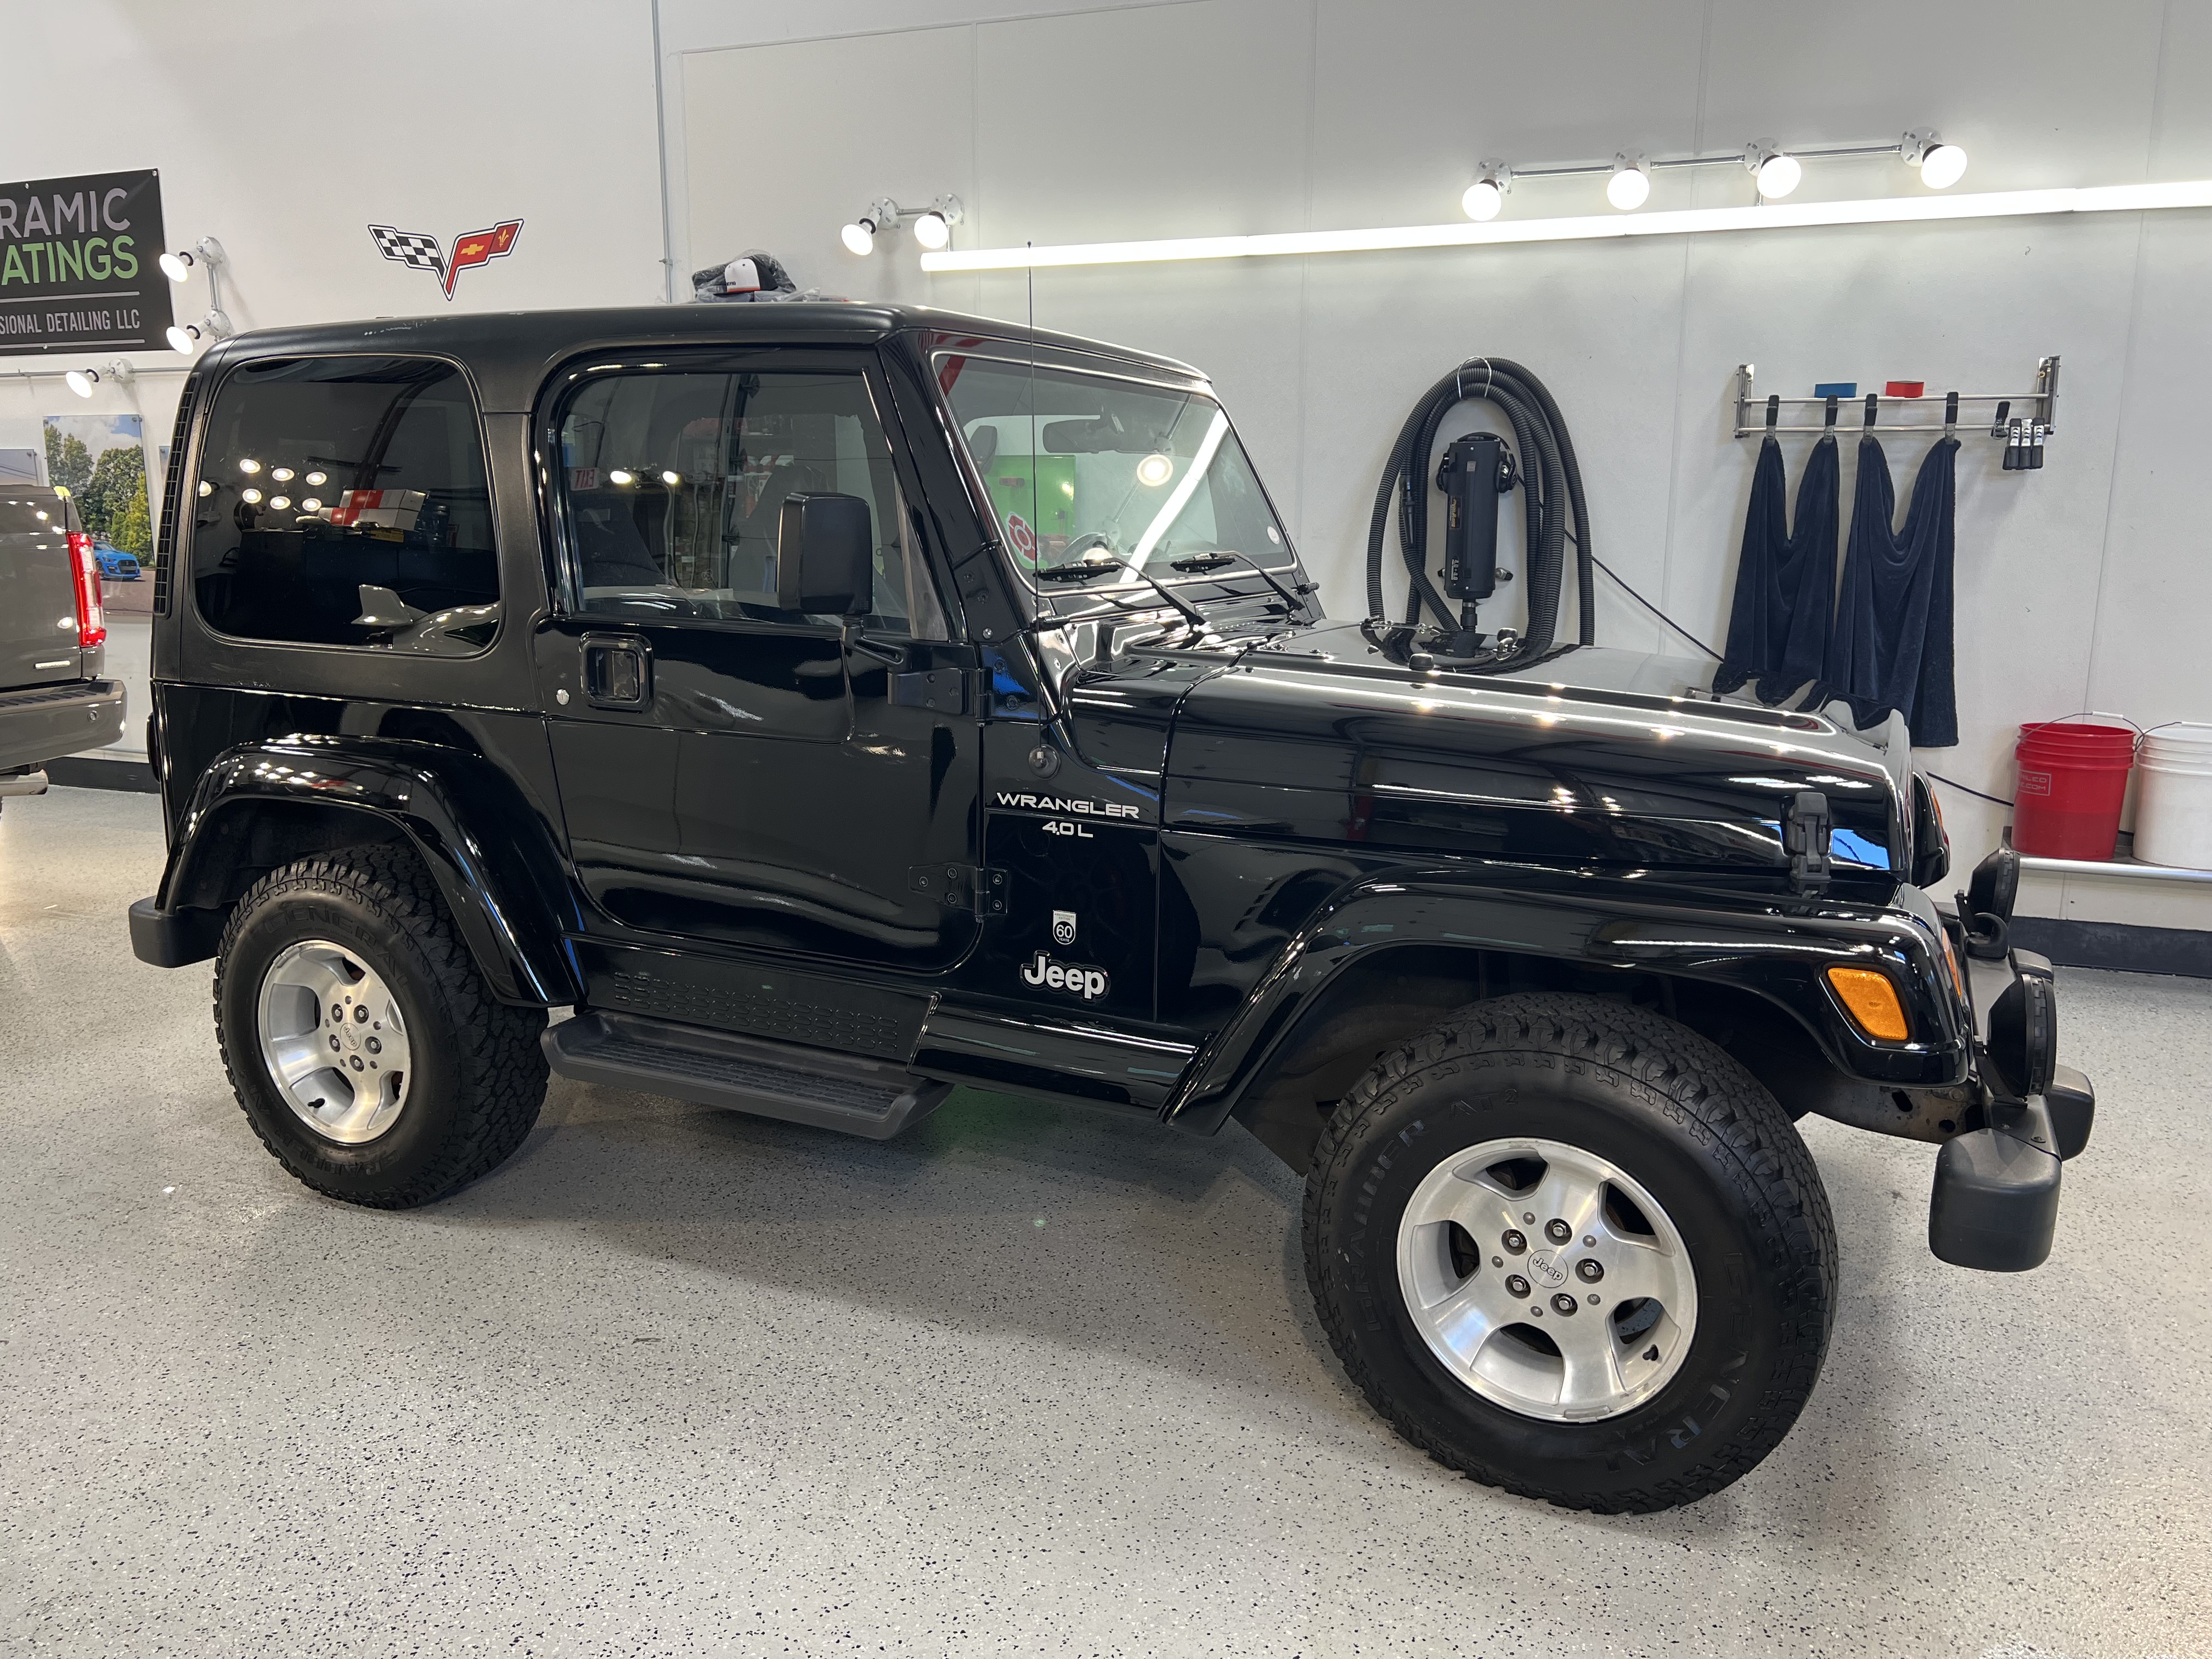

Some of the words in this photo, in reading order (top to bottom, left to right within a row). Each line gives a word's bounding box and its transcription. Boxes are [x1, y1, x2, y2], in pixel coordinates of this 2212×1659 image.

[1, 235, 138, 286] ATINGS
[46, 310, 110, 332] DETAILING
[116, 309, 140, 329] LLC
[996, 792, 1139, 819] WRANGLER
[1056, 924, 1073, 939] 60
[263, 905, 409, 1004] GENERAL
[1024, 956, 1105, 999] Jeep
[343, 1026, 357, 1047] Jeep
[1348, 1119, 1427, 1331] GRABBER
[1532, 1257, 1563, 1280] Jeep
[1579, 1252, 1753, 1472] GENERAL
